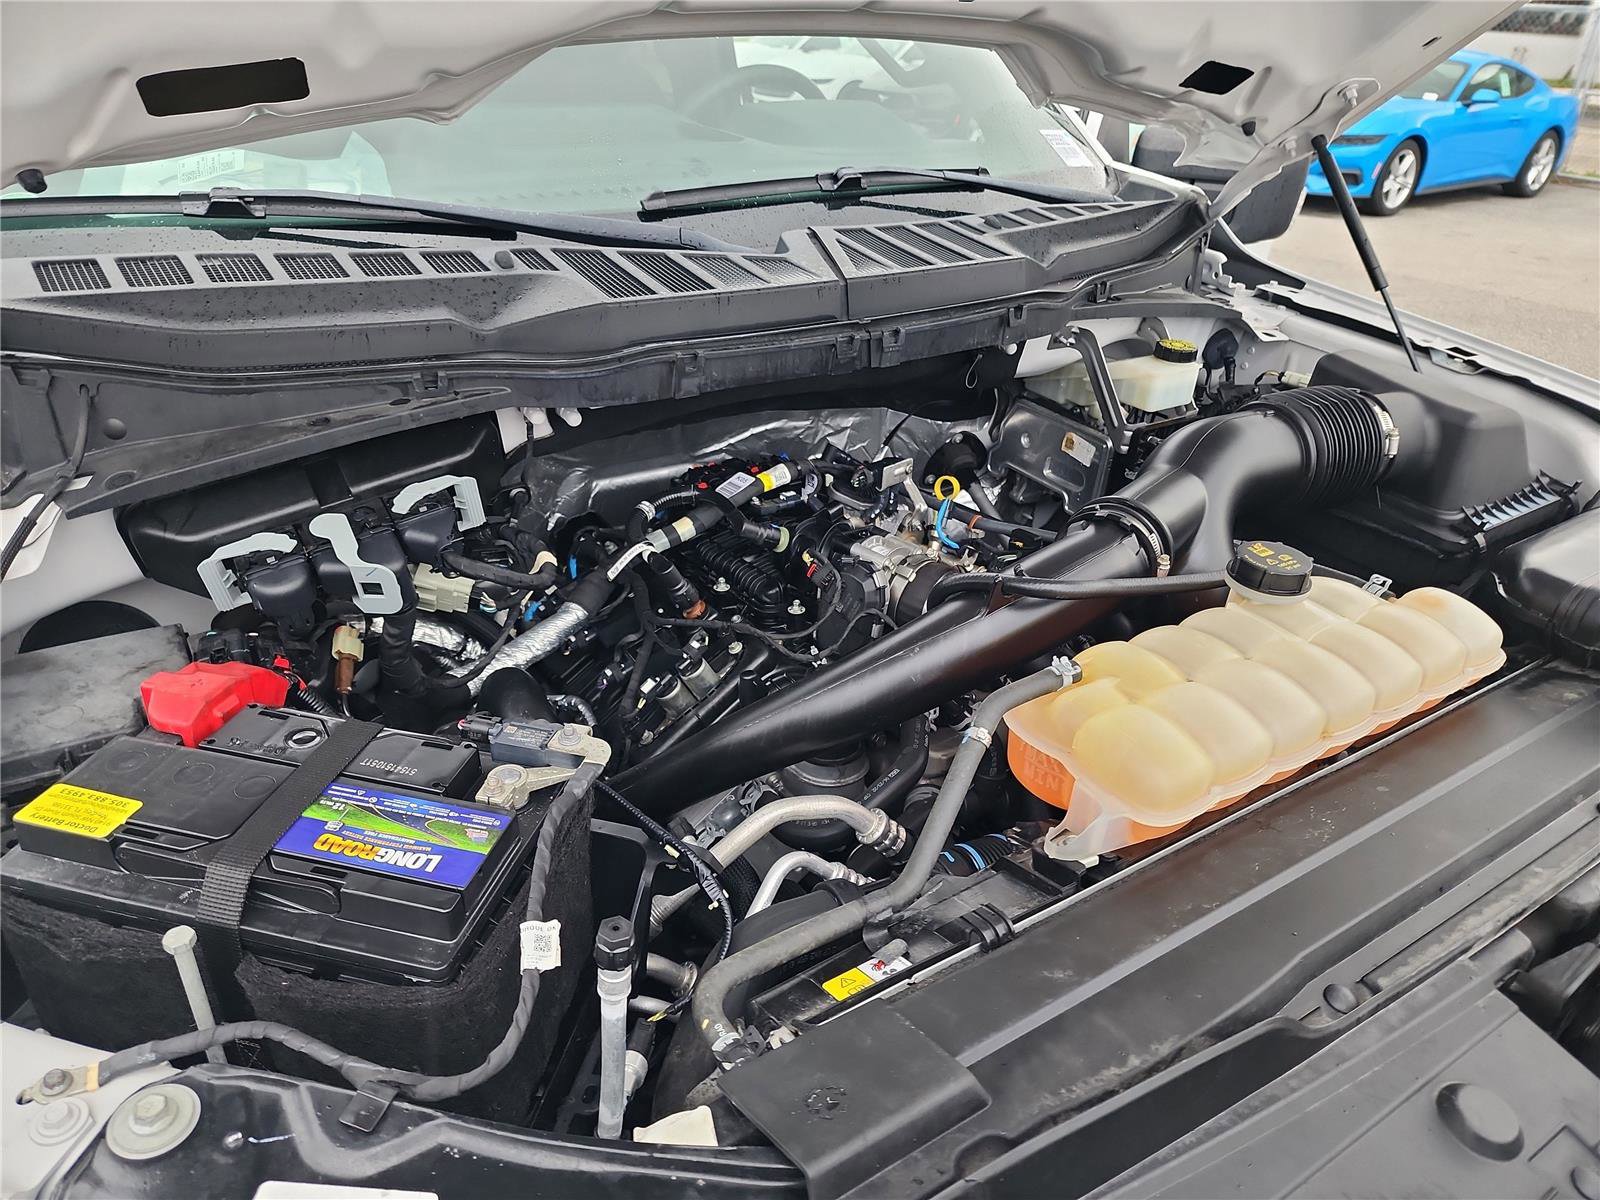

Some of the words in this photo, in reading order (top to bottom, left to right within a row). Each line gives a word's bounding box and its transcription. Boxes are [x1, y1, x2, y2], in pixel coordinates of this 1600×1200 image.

[332, 802, 346, 811] 12
[28, 812, 65, 826] Battery
[66, 821, 98, 834] Doctor
[313, 833, 443, 873] LONGROAD
